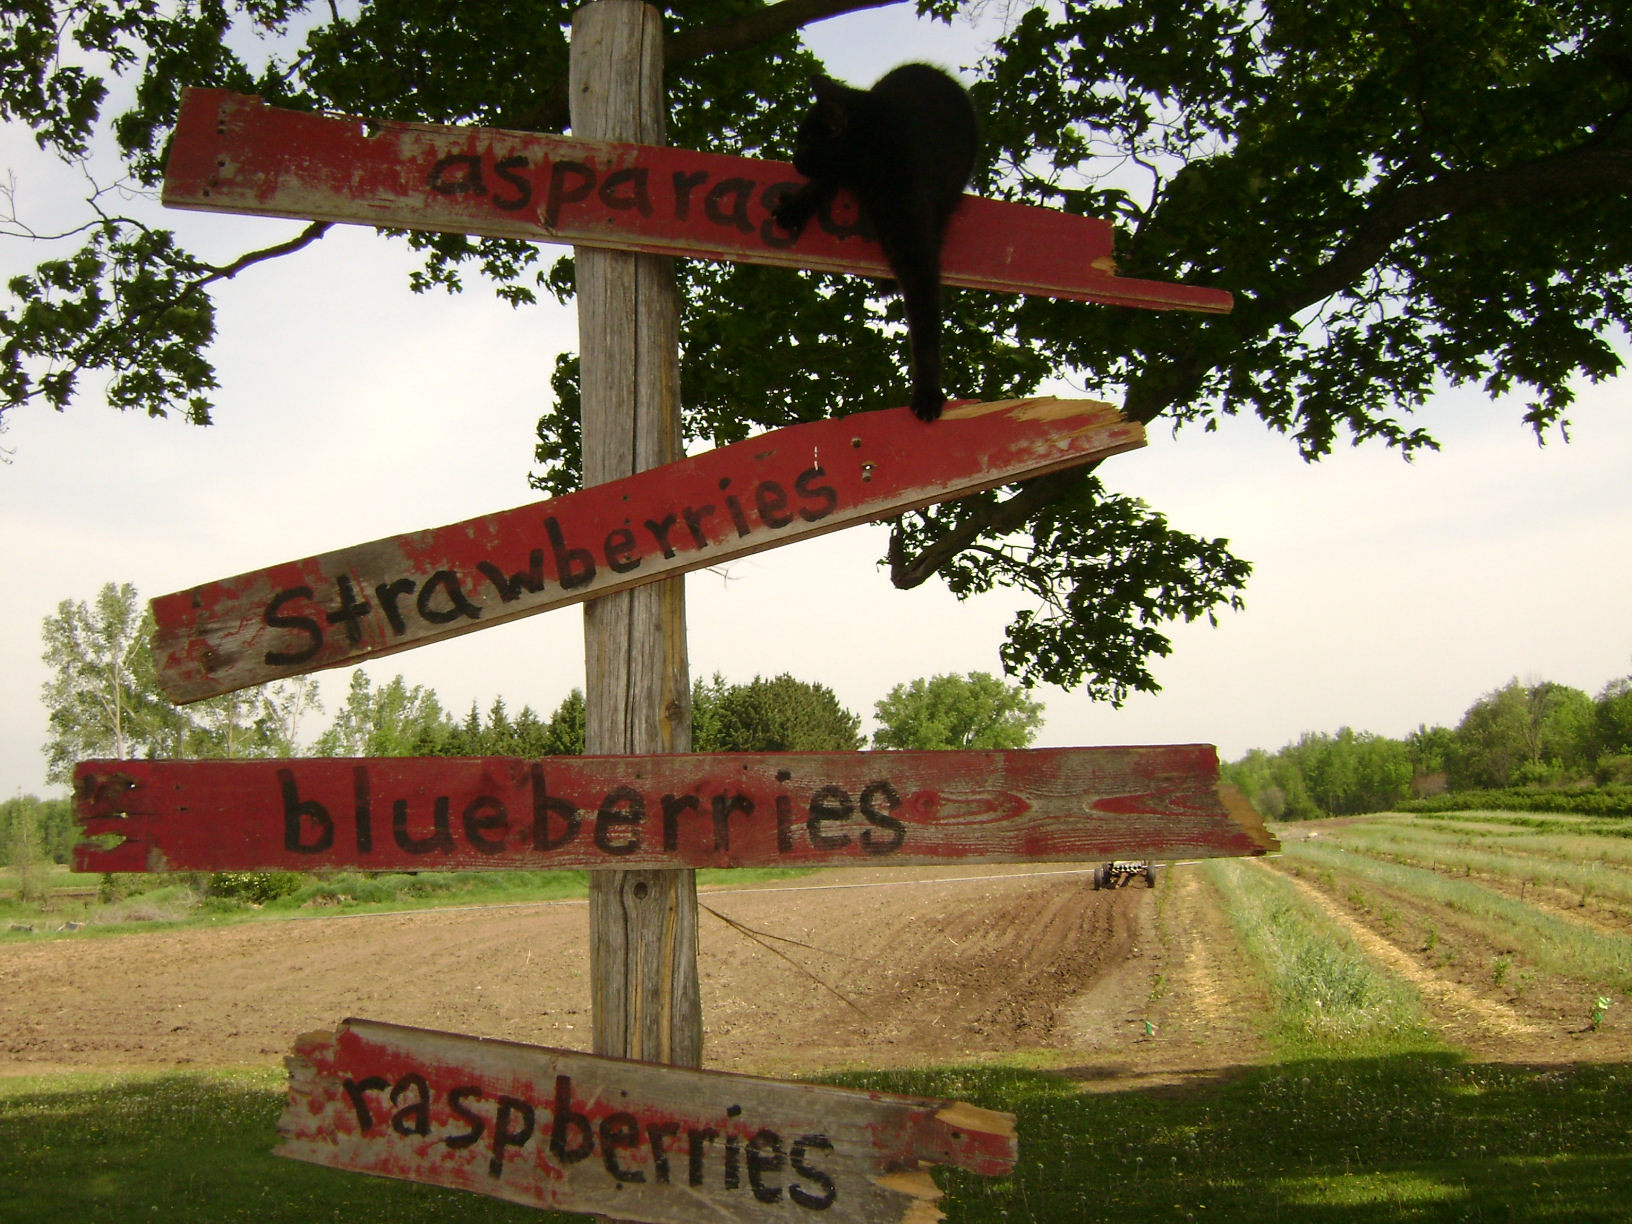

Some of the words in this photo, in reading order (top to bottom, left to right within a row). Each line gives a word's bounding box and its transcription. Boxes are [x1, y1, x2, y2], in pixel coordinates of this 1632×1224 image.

[428, 154, 881, 249] asparagu
[276, 763, 907, 856] blueberries
[342, 1075, 837, 1211] raspberries
